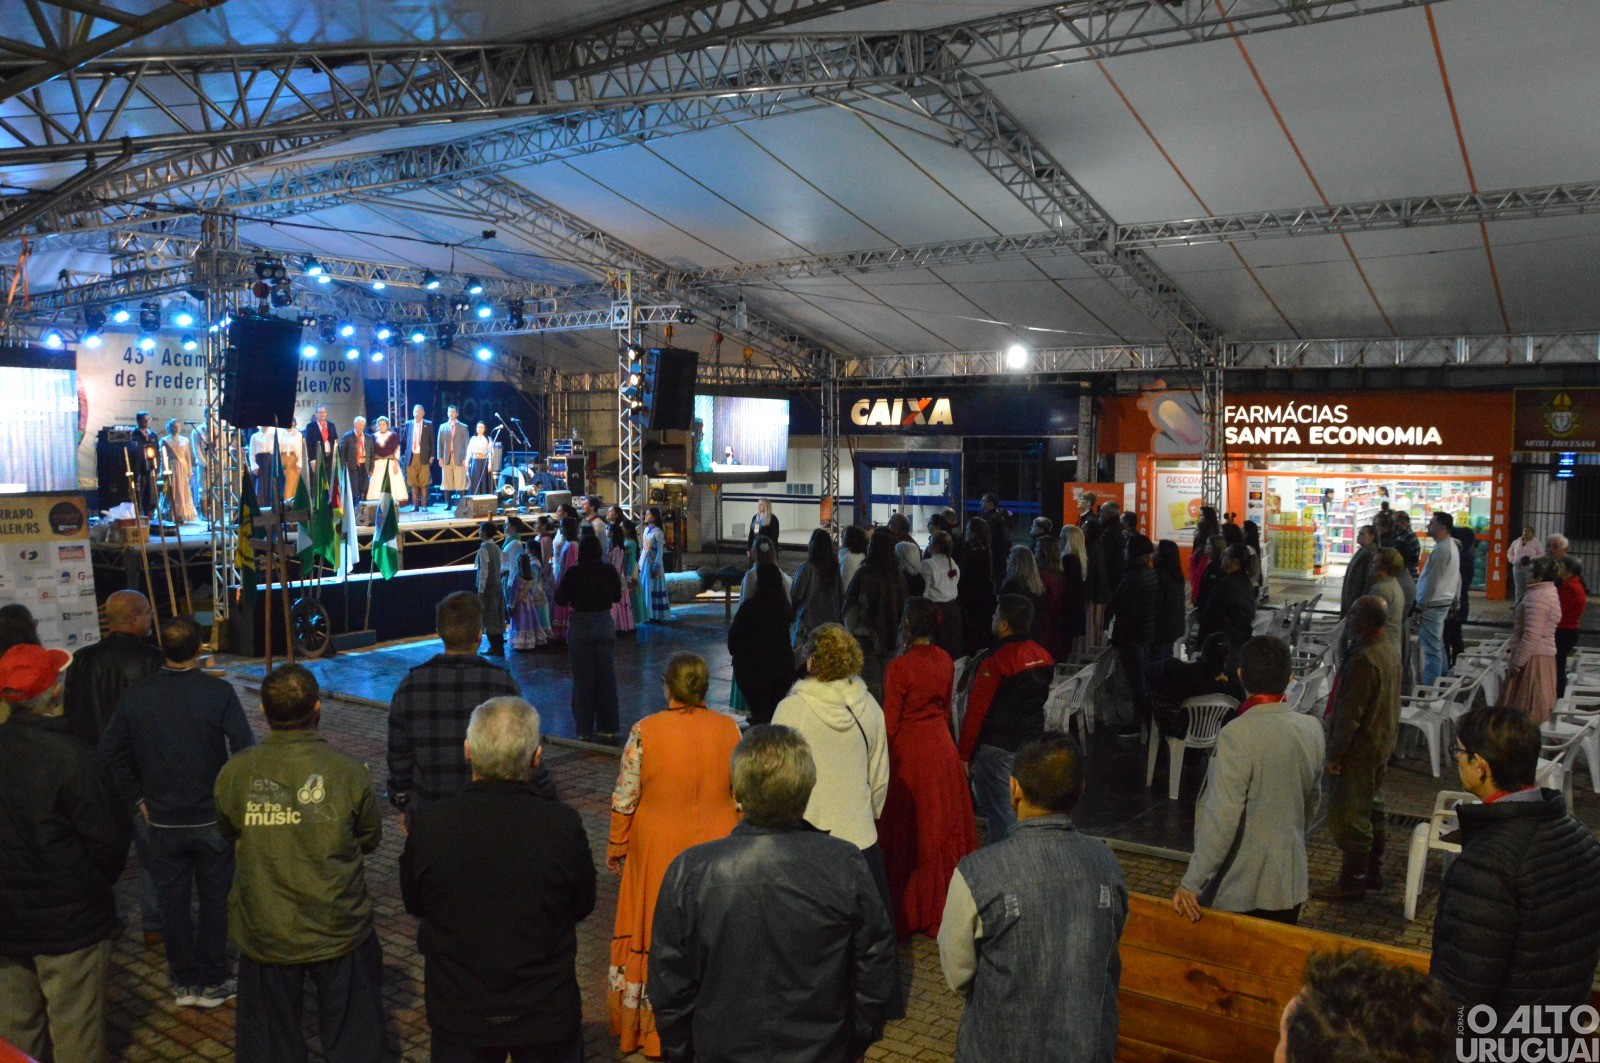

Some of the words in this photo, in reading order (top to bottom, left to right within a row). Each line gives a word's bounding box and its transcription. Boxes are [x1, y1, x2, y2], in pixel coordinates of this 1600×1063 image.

[115, 369, 136, 387] de
[156, 397, 167, 406] DE
[173, 397, 184, 406] 13
[188, 398, 194, 406] A
[851, 398, 954, 426] CAIXA
[1224, 401, 1348, 424] FARMÁCIAS
[1225, 426, 1301, 445] SANTA
[1309, 426, 1443, 445] ECONOMIA
[1166, 476, 1202, 484] DESCON
[246, 801, 261, 812] for
[264, 801, 281, 812] the
[244, 807, 301, 826] music
